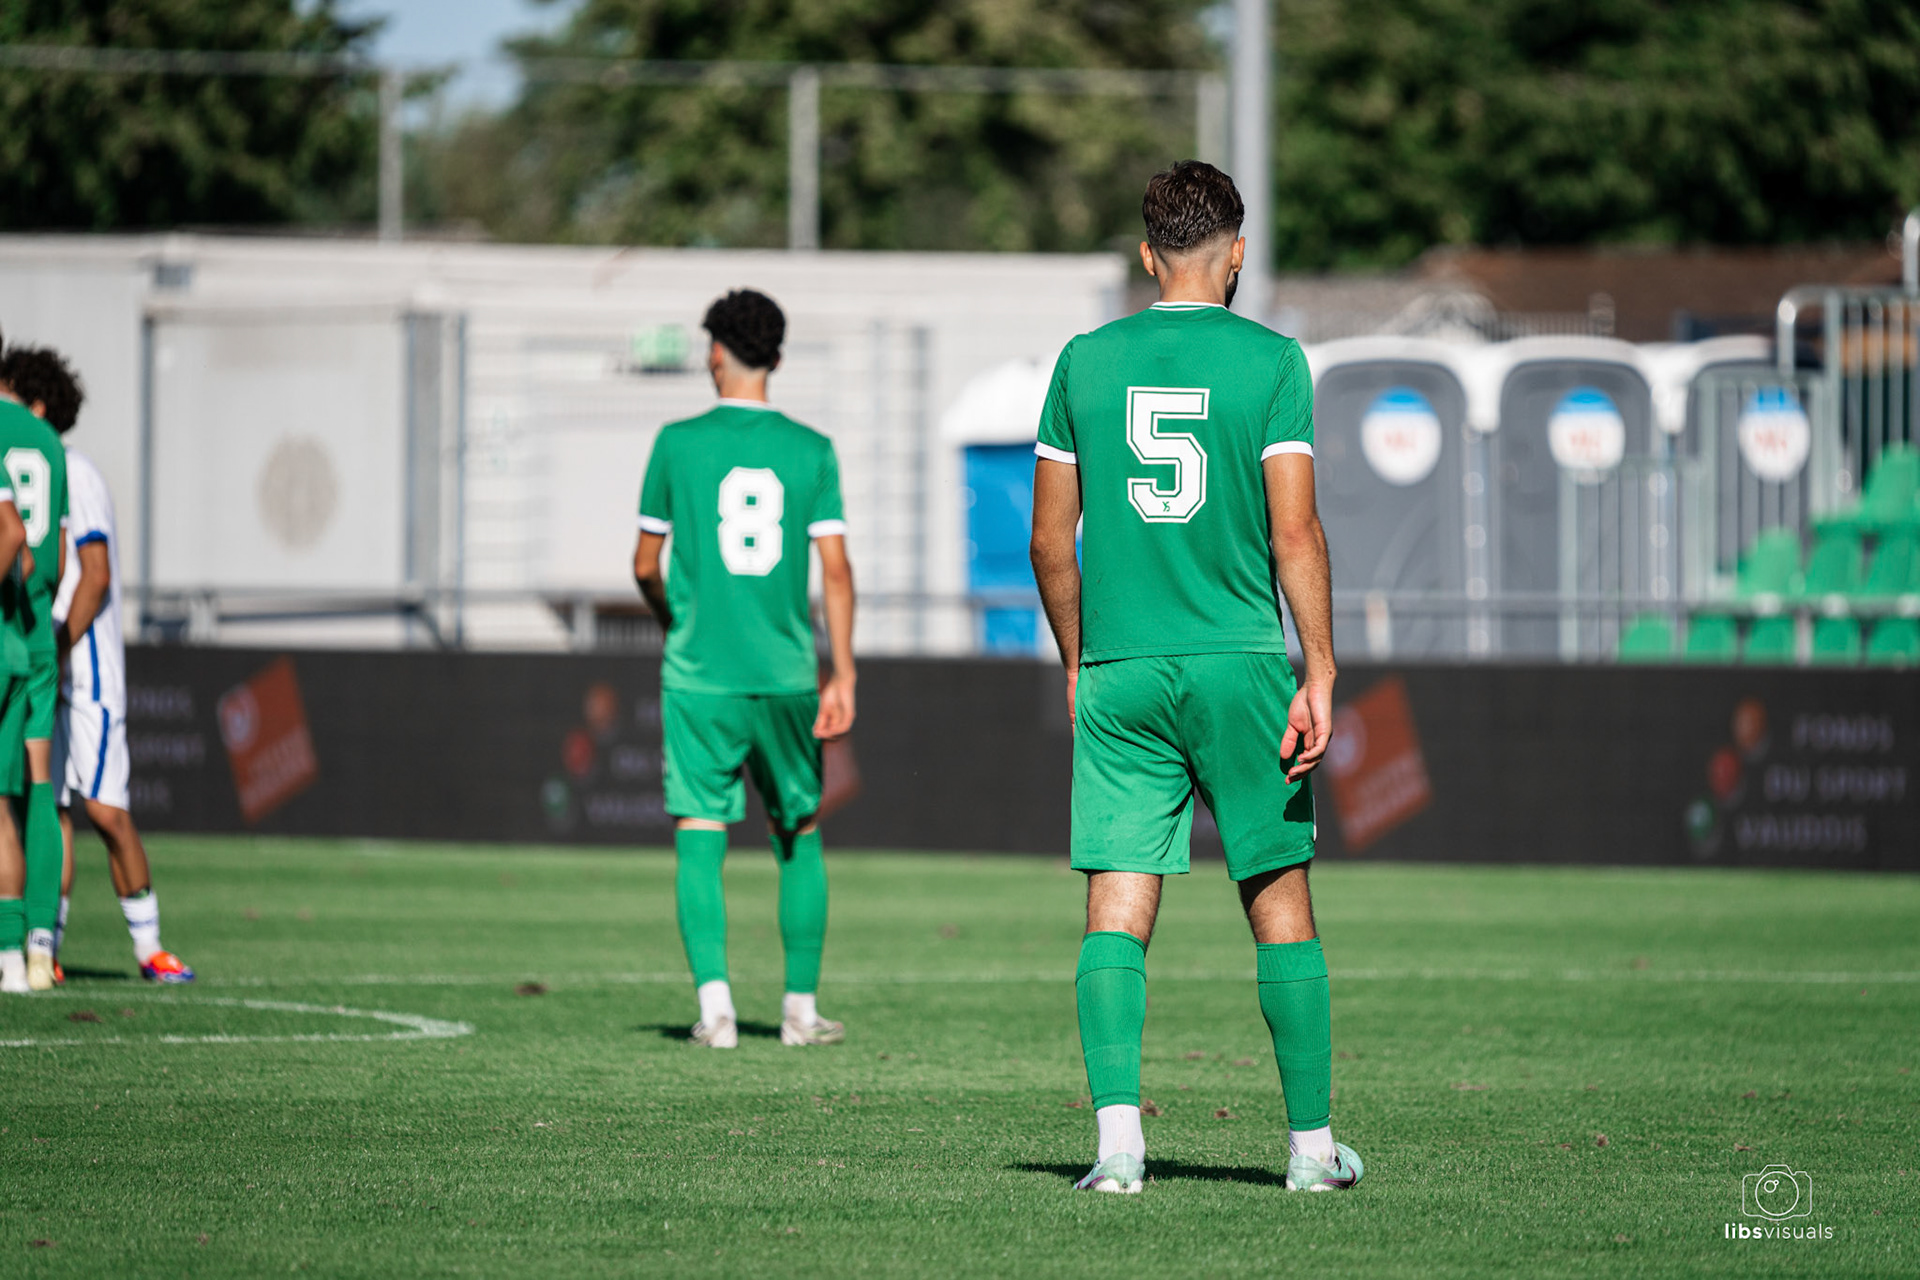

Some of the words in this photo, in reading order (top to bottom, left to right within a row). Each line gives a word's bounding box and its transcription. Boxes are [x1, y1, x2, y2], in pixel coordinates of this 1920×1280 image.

[3, 447, 51, 547] 9
[1126, 386, 1210, 524] 5
[717, 466, 785, 577] 8
[1792, 715, 1894, 752] FONDS
[1764, 766, 1810, 802] DU
[1816, 766, 1906, 803] SPORT
